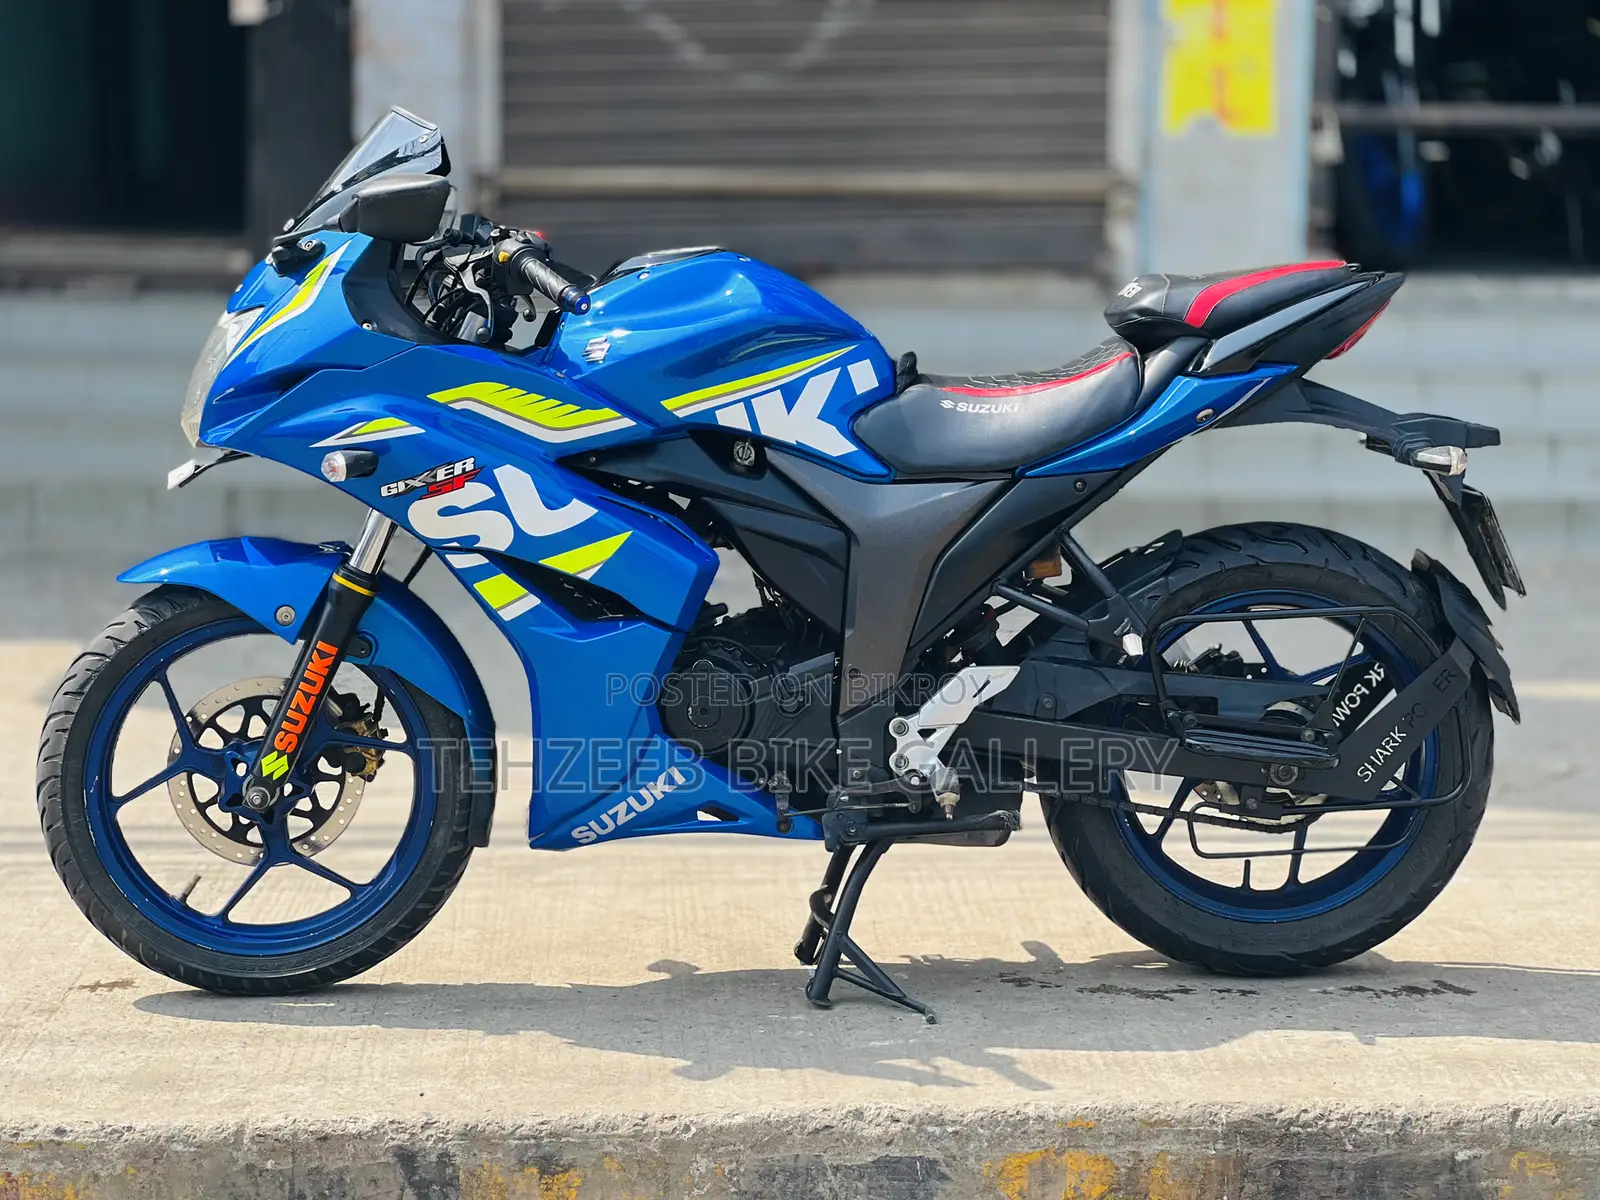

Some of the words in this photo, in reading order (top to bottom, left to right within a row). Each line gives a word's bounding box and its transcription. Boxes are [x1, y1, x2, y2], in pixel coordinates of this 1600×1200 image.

[955, 402, 1021, 414] SUZUKI
[421, 467, 483, 499] SF
[273, 640, 339, 754] SUZUKI
[1356, 725, 1407, 783] SHARK
[1402, 668, 1459, 728] POER
[571, 766, 686, 844] SUZUKI
